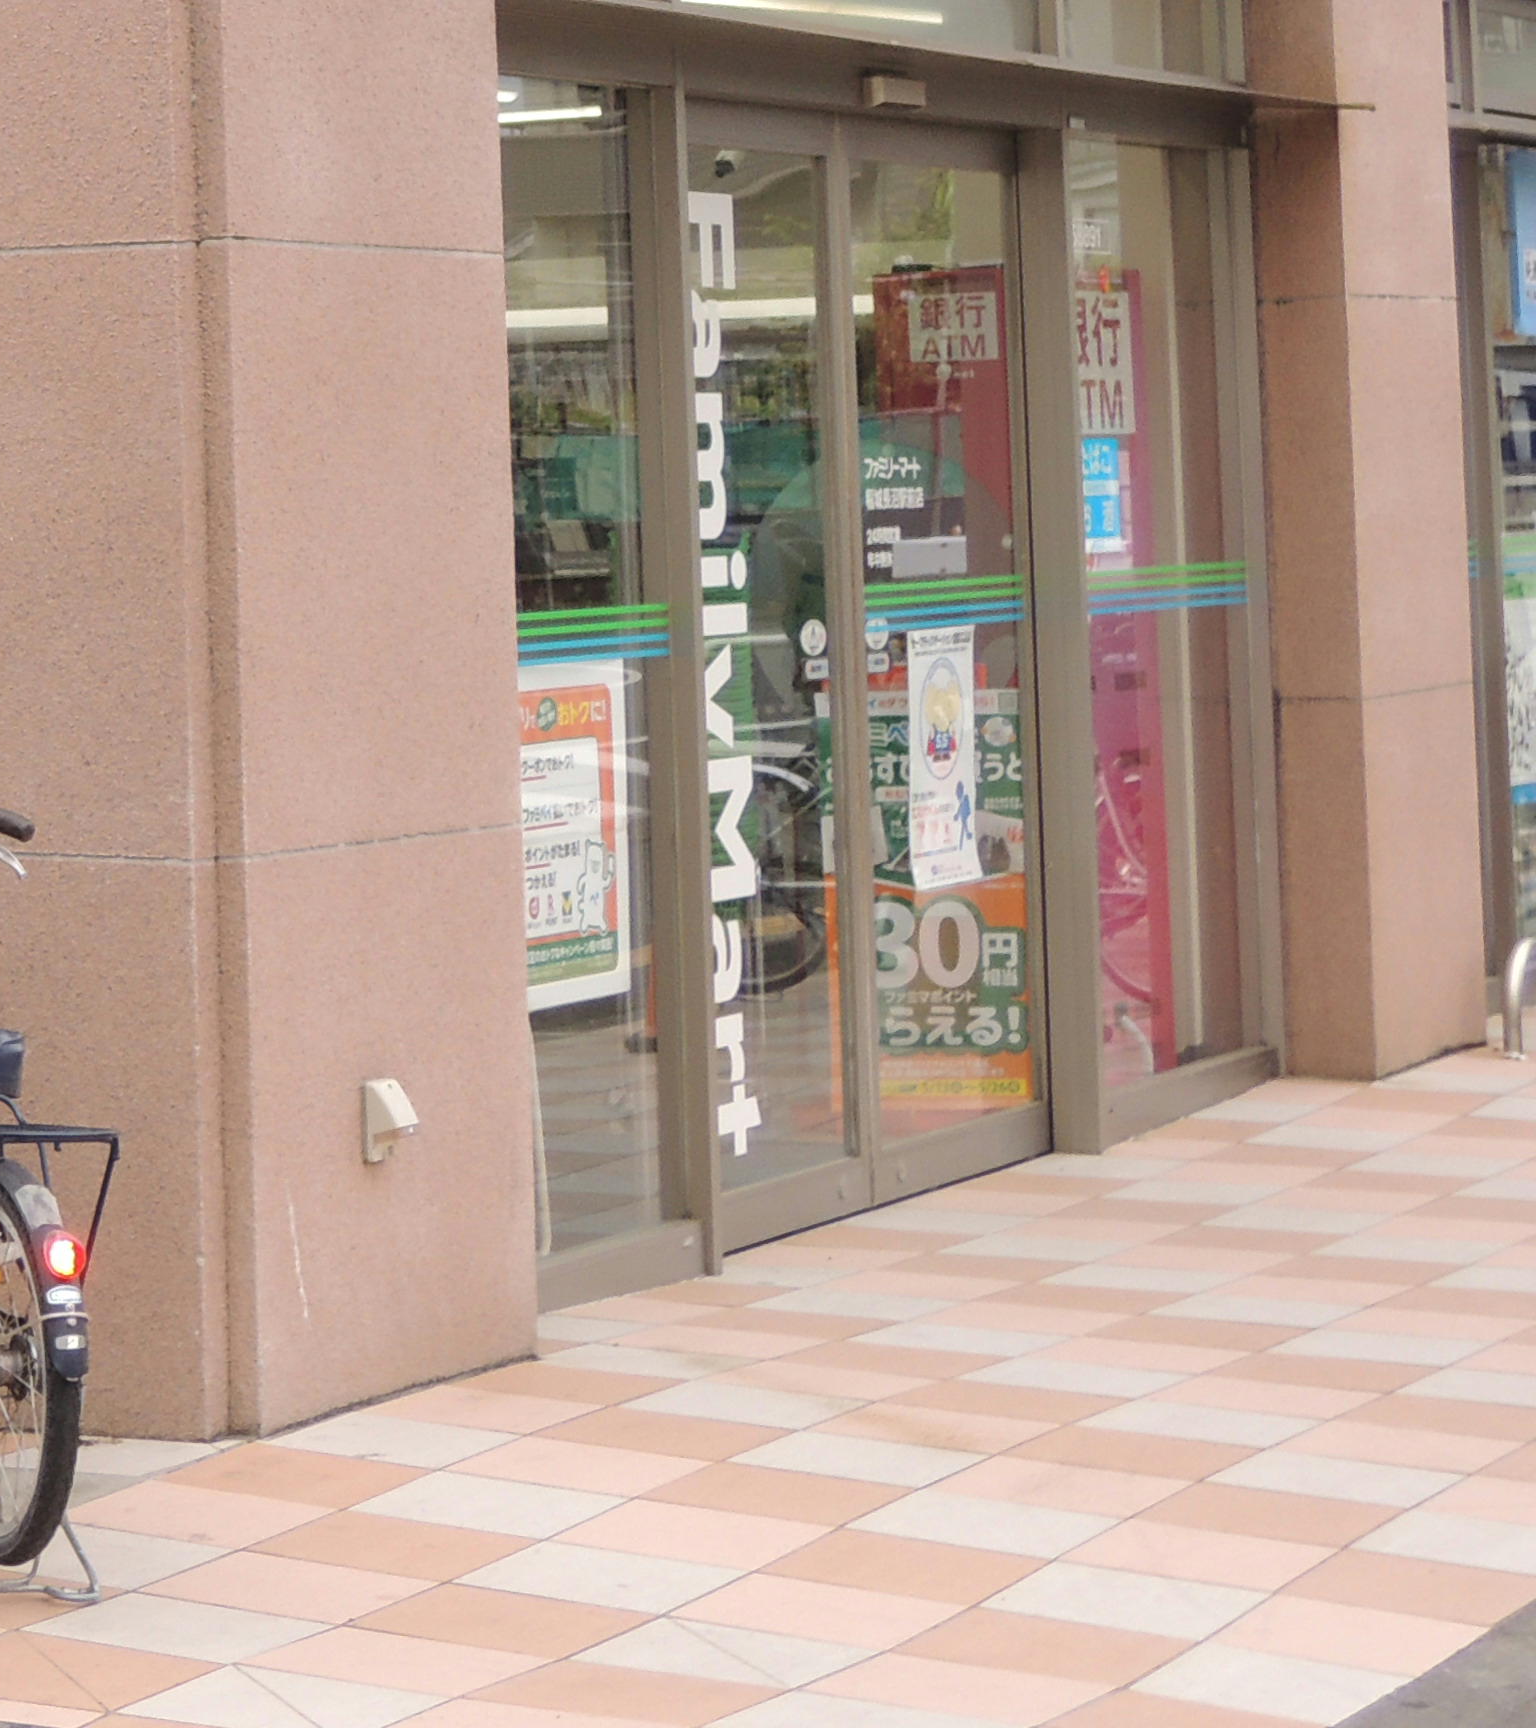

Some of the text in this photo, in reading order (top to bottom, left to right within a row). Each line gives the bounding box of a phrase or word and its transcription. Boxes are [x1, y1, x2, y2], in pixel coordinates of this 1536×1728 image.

[919, 295, 986, 330] 銀行
[921, 333, 985, 359] ATM
[1080, 379, 1124, 429] TM
[864, 456, 922, 480] ファミリーマート
[688, 191, 763, 1157] FamilyMart
[874, 900, 1018, 989] 30 円
[983, 967, 1018, 987] 相当
